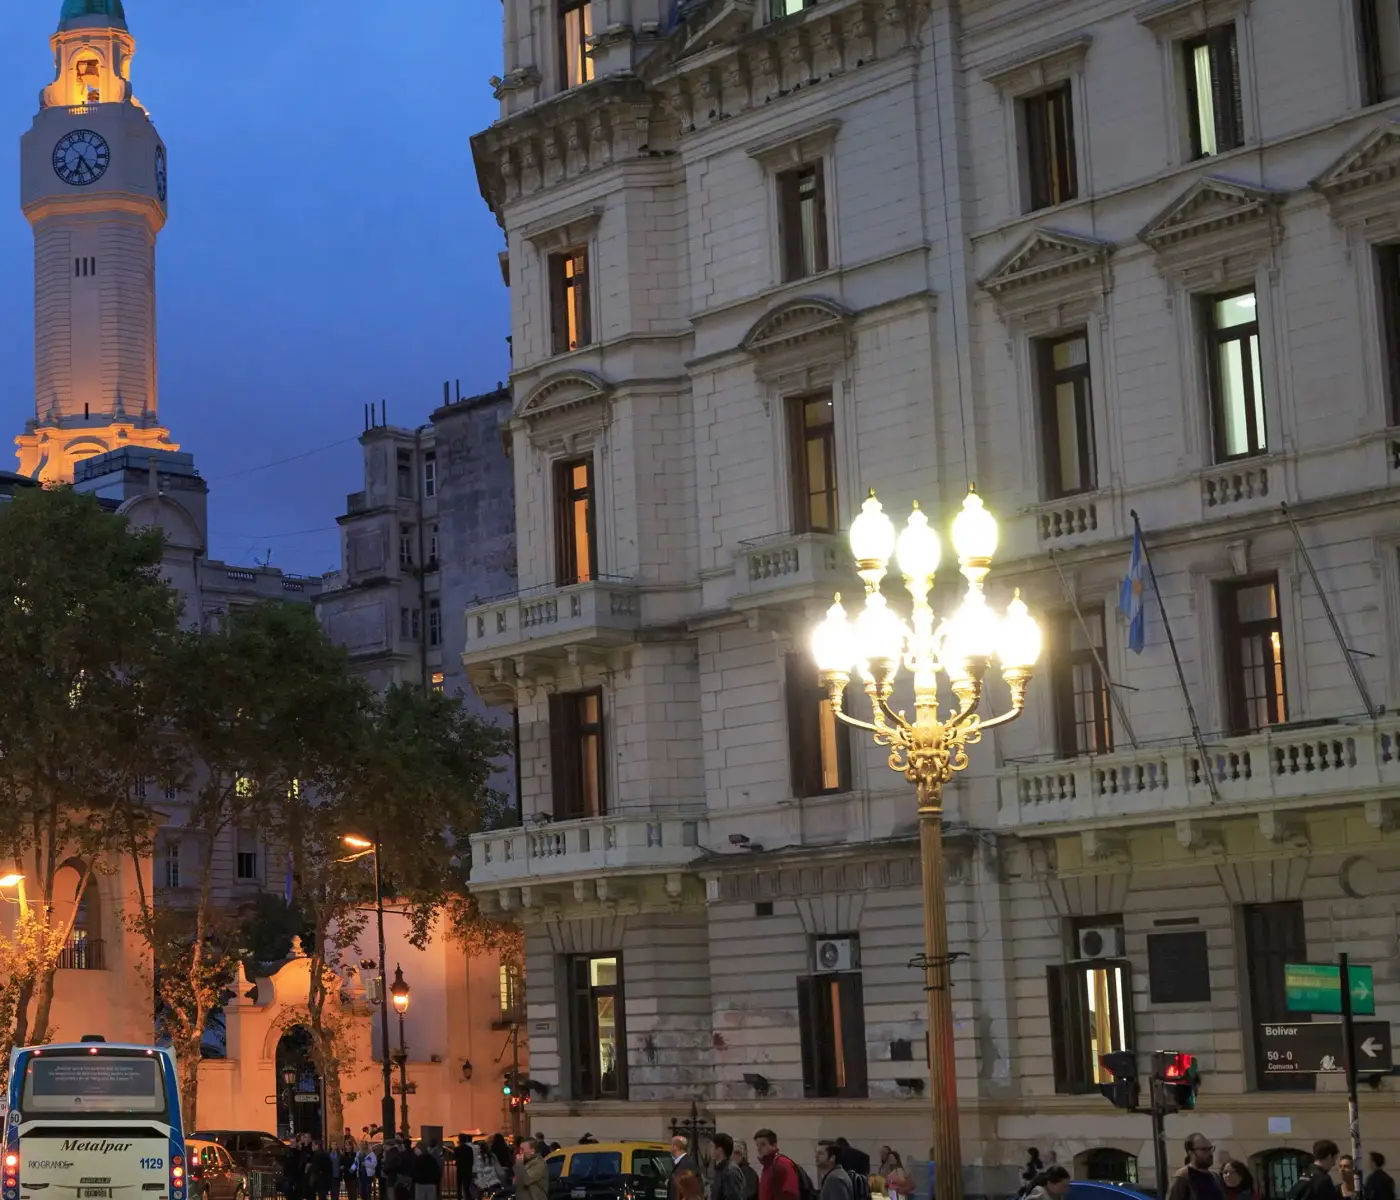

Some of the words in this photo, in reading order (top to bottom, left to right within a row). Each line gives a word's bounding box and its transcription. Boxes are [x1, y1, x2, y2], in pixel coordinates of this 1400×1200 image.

[1267, 1051, 1279, 1061] 50
[1286, 1051, 1293, 1061] 0
[10, 1113, 20, 1123] 60
[60, 1139, 133, 1154] Metalpar
[140, 1158, 164, 1169] 1129
